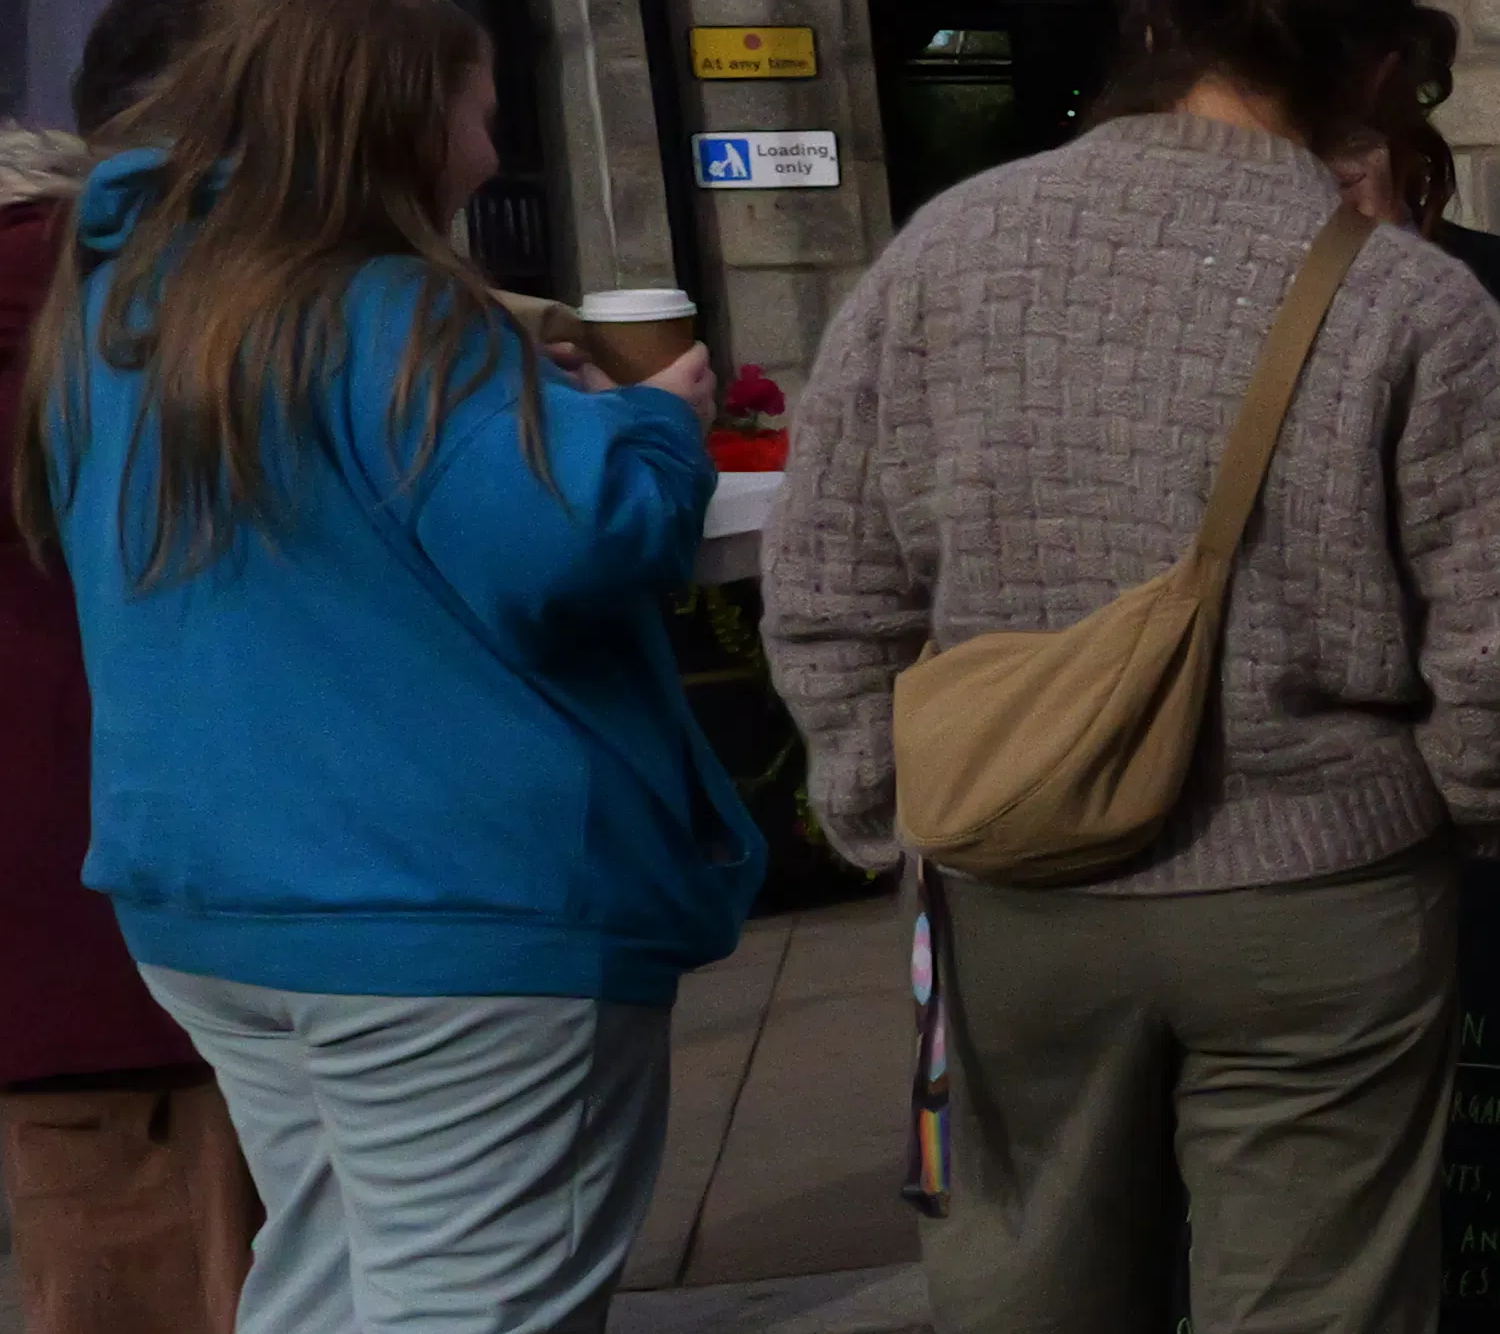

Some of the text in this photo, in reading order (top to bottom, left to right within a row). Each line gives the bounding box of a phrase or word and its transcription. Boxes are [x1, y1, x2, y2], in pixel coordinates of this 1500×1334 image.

[702, 57, 808, 72] At any time
[757, 144, 828, 159] Loading
[775, 162, 813, 175] only
